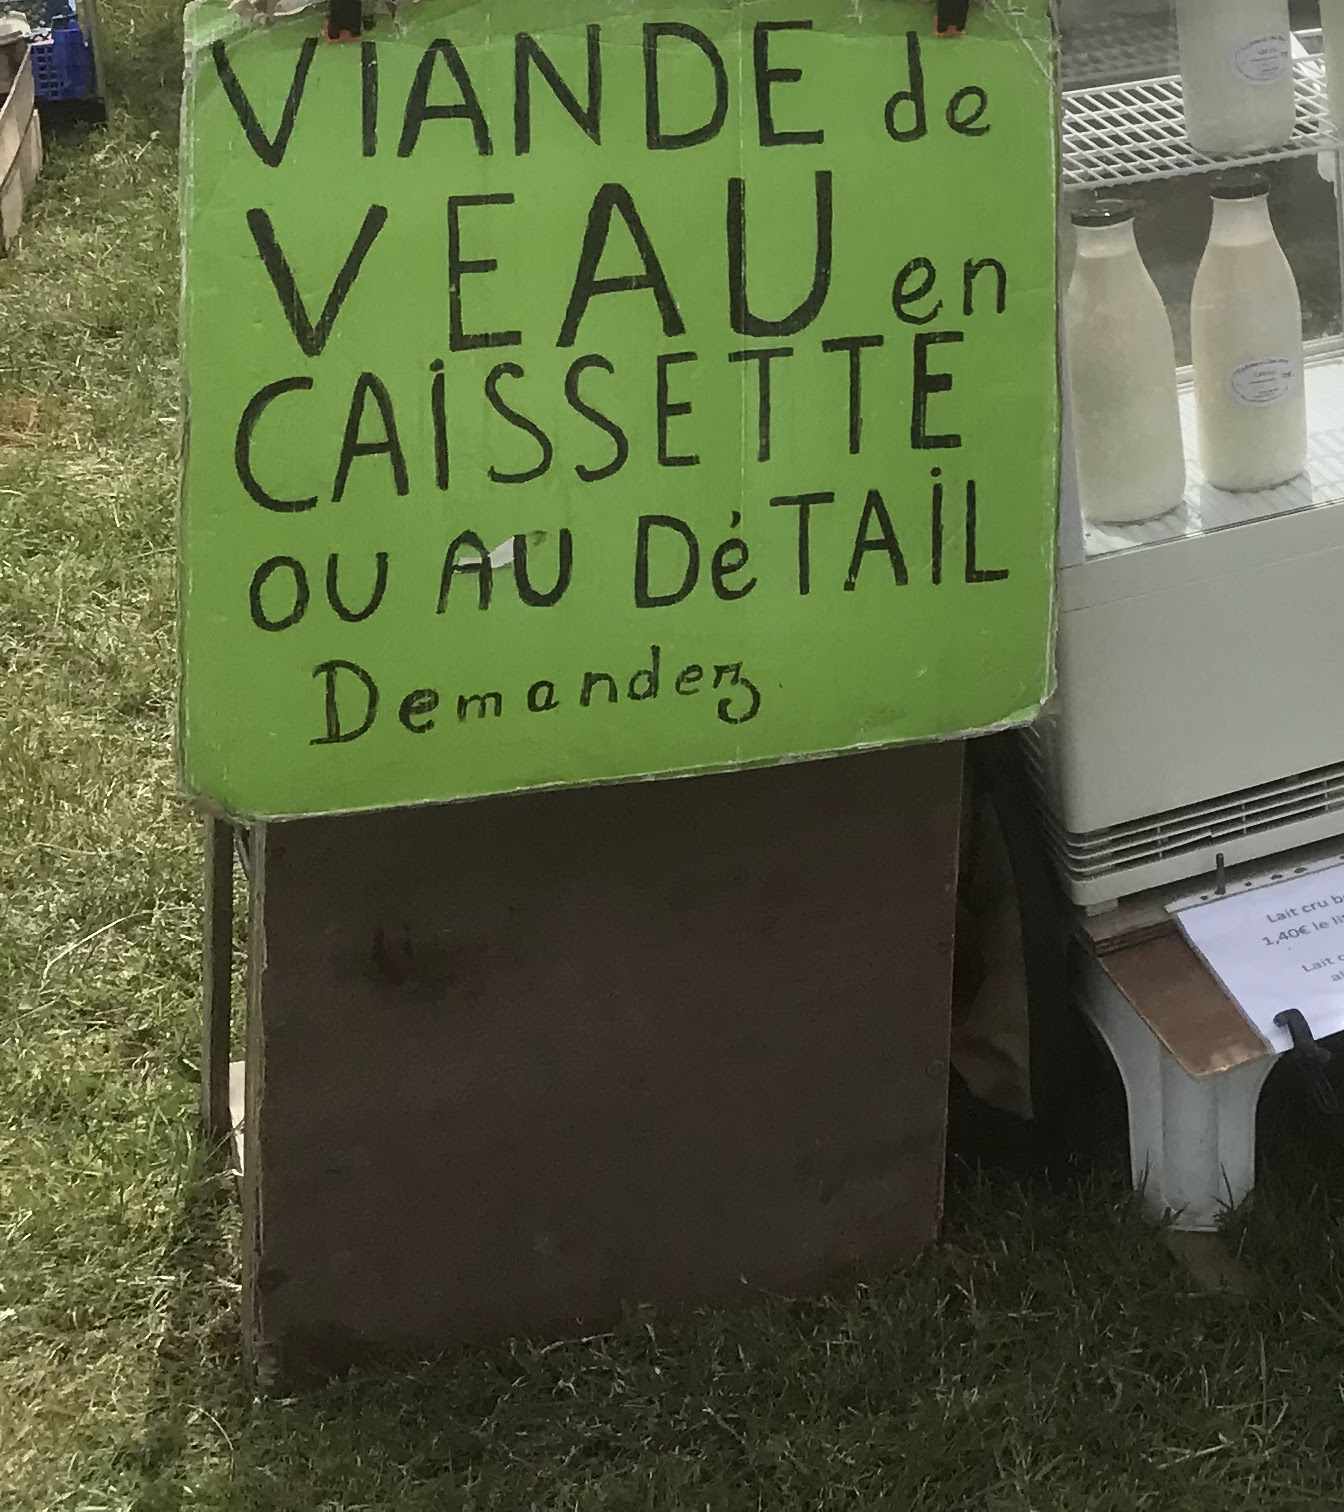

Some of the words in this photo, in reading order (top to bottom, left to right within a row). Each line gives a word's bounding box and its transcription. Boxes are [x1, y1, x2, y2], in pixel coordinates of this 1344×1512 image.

[212, 19, 825, 168] VIANDE
[885, 30, 993, 143] de
[246, 169, 834, 357] VEAU
[892, 255, 1007, 325] en
[248, 550, 391, 634] OU
[436, 527, 574, 616] AU
[309, 644, 763, 746] Demandez
[1262, 925, 1311, 946] 1,40€
[1312, 920, 1329, 931] le
[1266, 907, 1299, 924] Lait
[1301, 899, 1329, 914] cru
[1301, 956, 1334, 973] Lait
